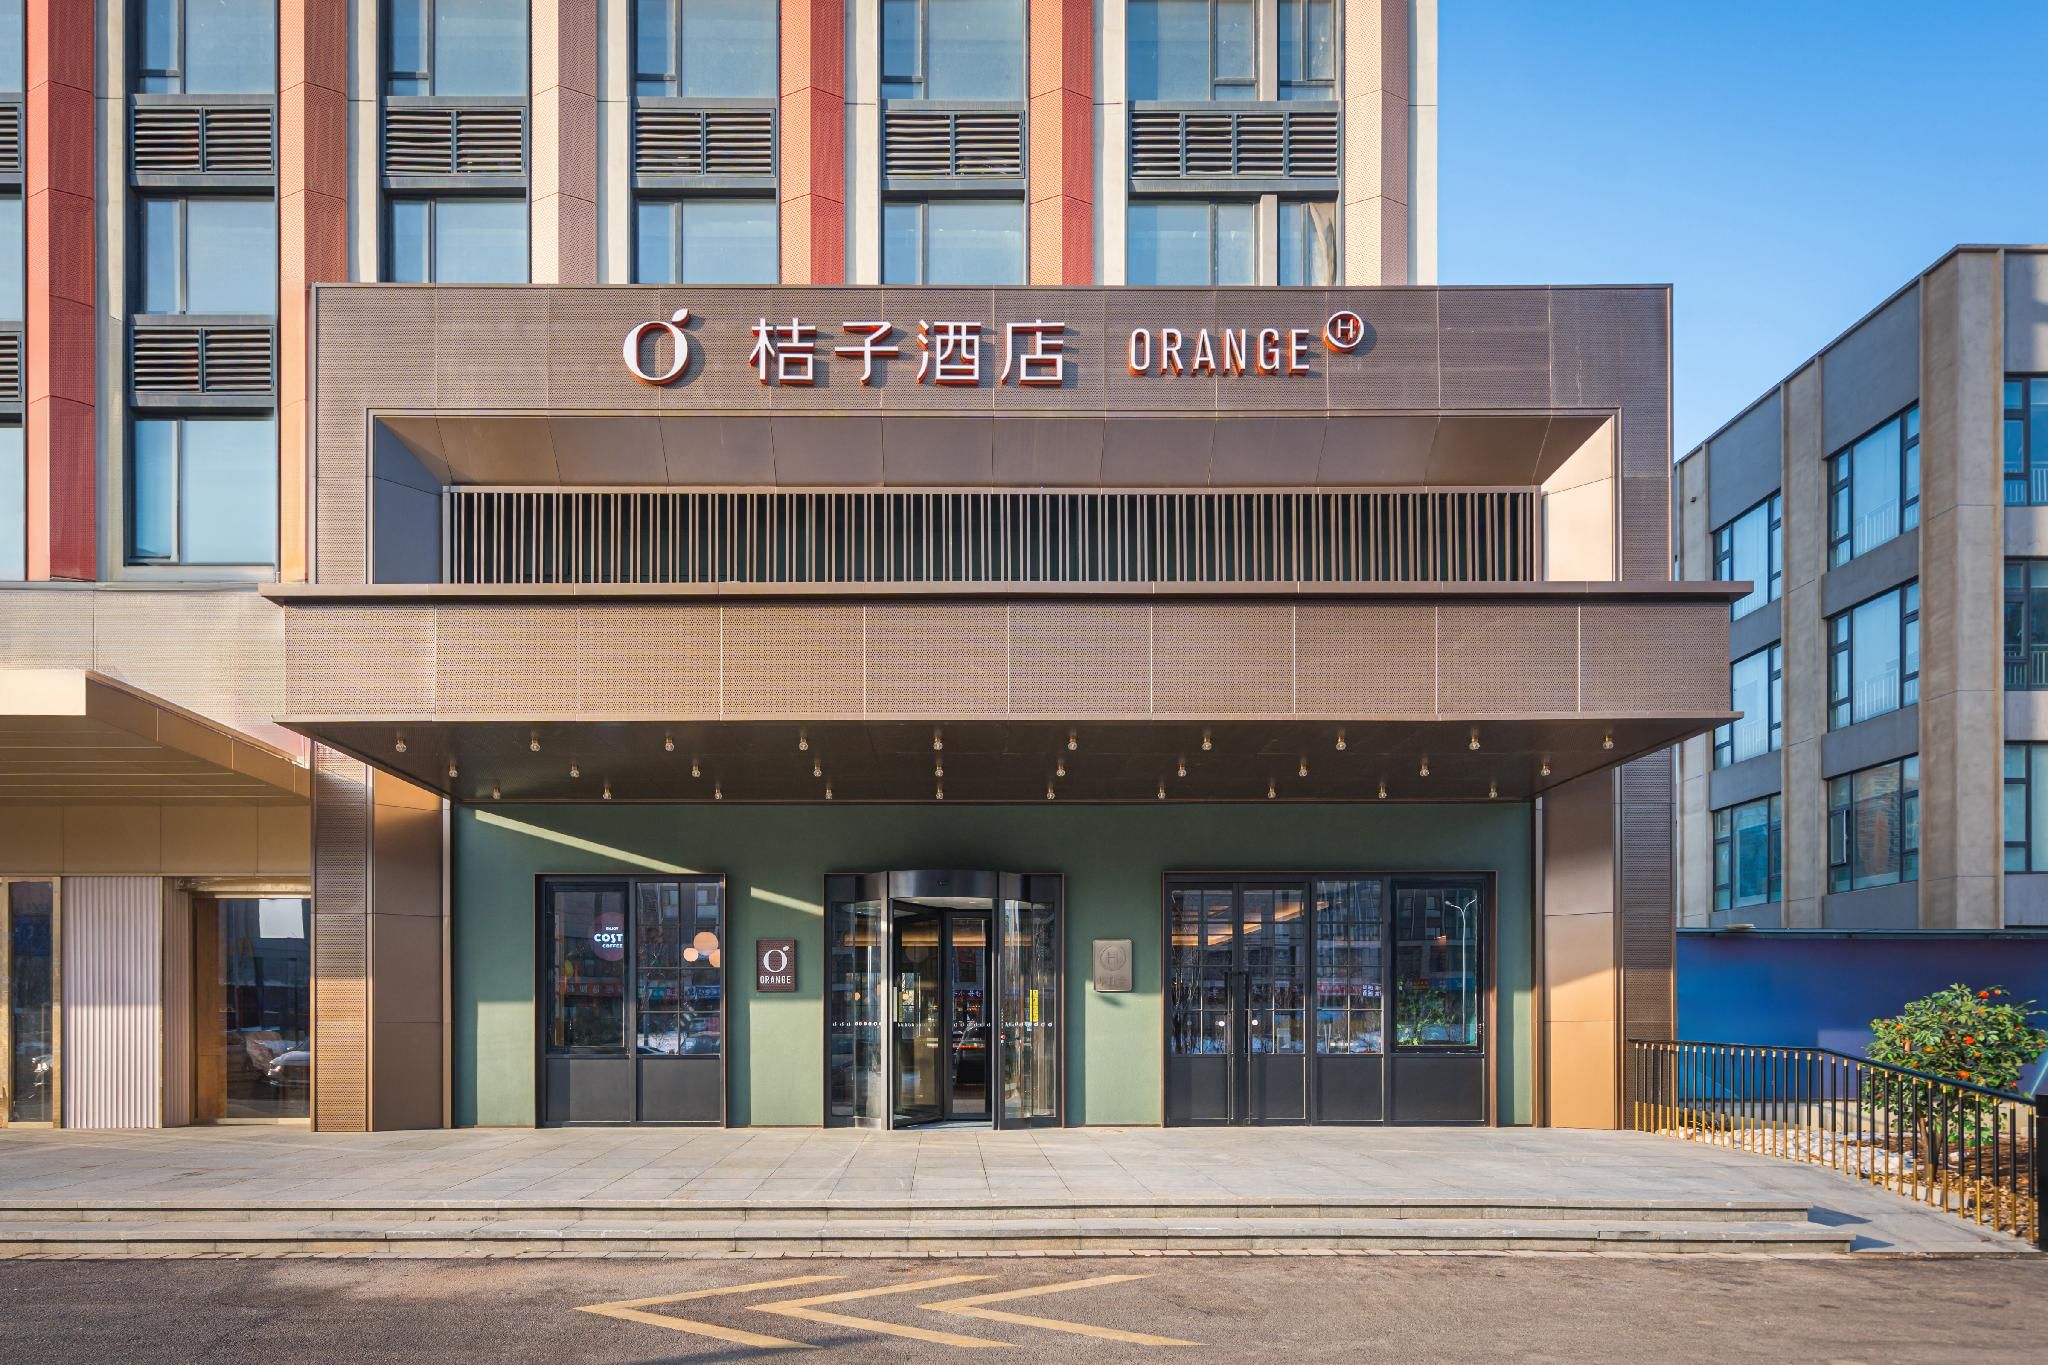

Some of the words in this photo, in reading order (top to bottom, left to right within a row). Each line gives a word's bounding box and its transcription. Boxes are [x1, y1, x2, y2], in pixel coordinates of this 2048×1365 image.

[750, 317, 1065, 385] 桔子酒店
[1128, 328, 1310, 373] ORANGE
[760, 975, 792, 984] ORANGE
